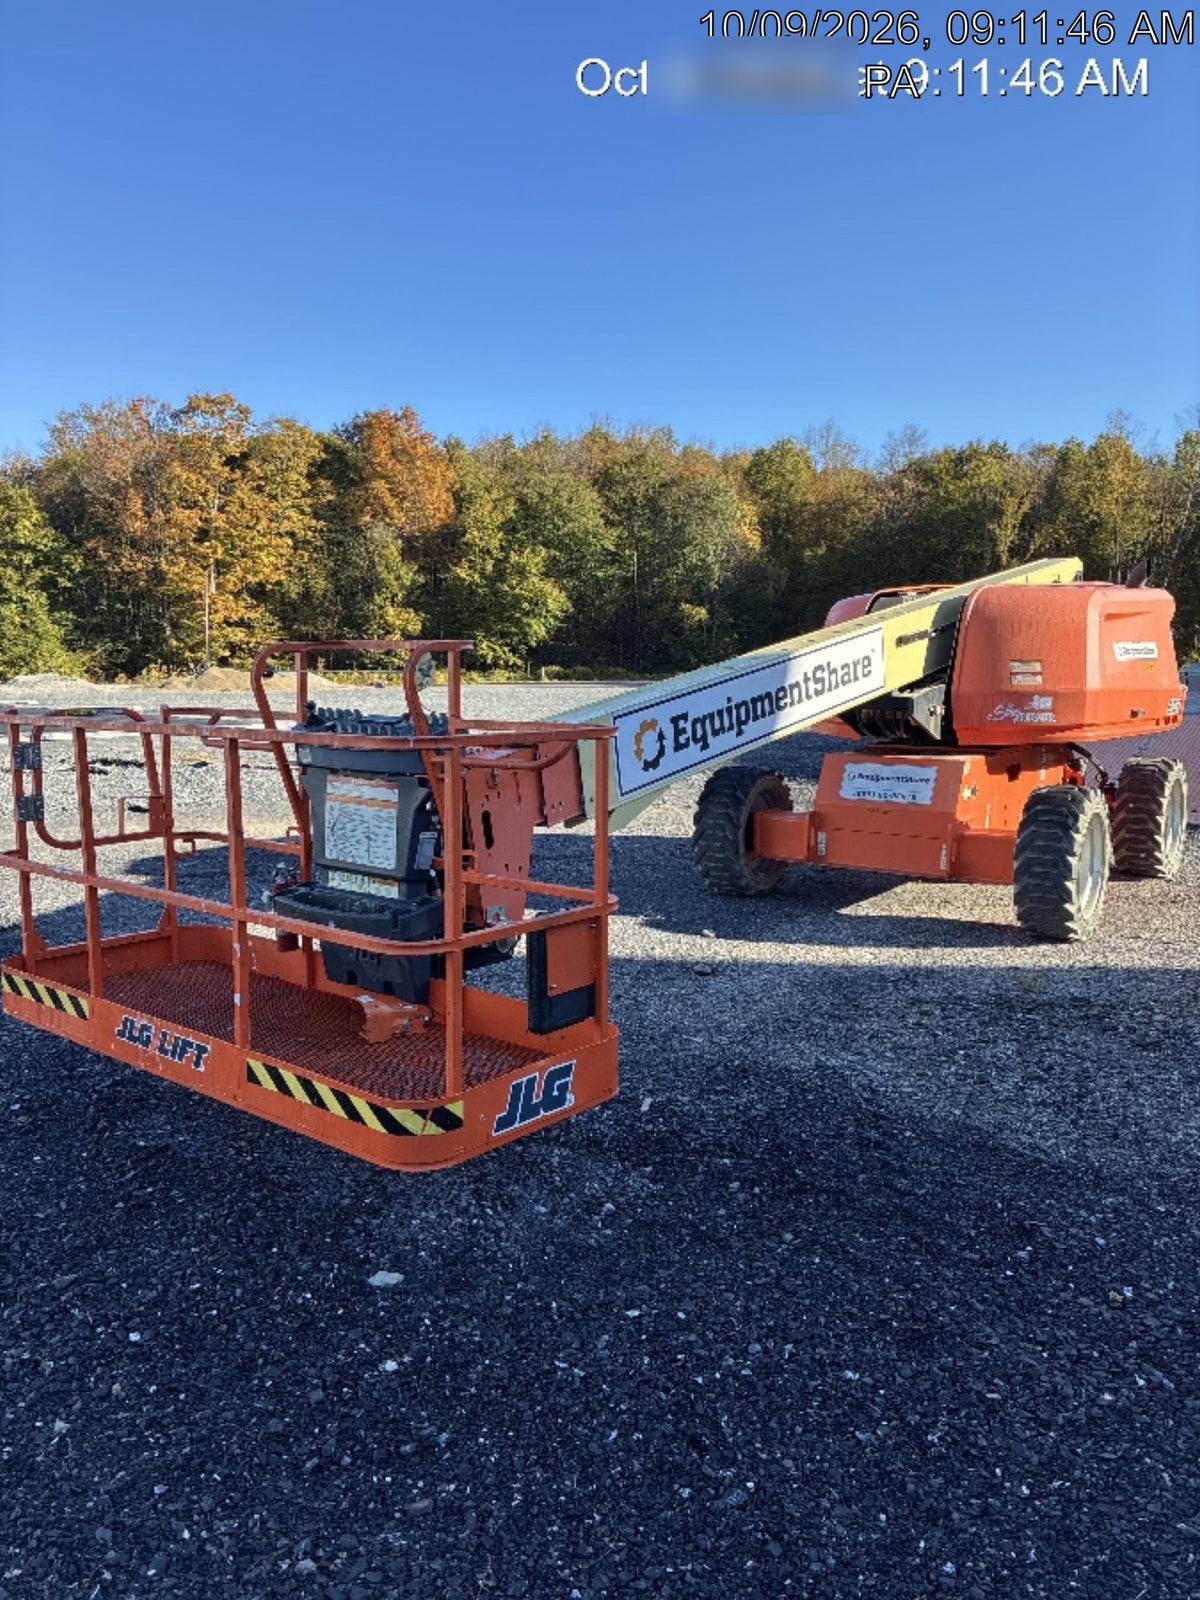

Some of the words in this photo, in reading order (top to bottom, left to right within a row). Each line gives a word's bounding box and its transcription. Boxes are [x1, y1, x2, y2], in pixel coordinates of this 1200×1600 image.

[670, 654, 873, 753] EquipmentShare
[115, 1015, 155, 1050] JLG
[156, 1029, 210, 1072] LIFT
[492, 1060, 575, 1136] JLG
